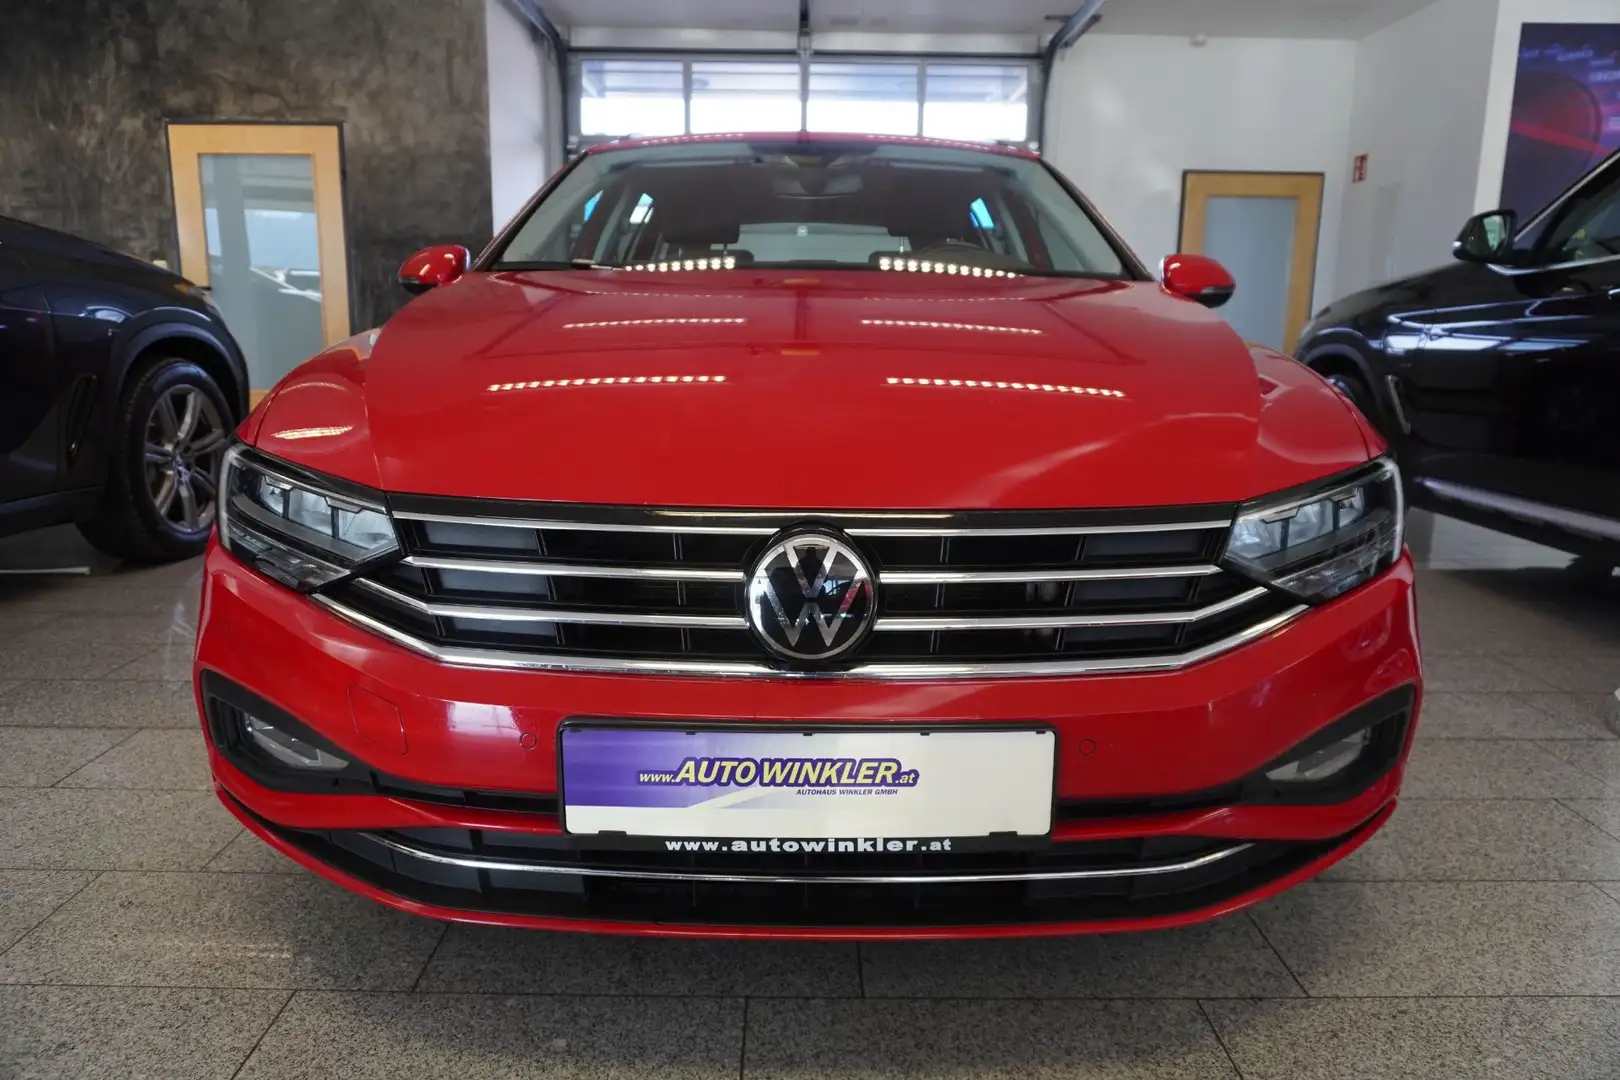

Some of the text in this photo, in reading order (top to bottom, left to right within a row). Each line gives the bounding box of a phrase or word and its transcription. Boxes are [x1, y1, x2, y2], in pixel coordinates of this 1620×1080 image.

[760, 540, 870, 650] VW
[795, 788, 899, 796] AUTOHAUS WINKLER GMBH
[664, 837, 952, 853] www.autowinkler.at
